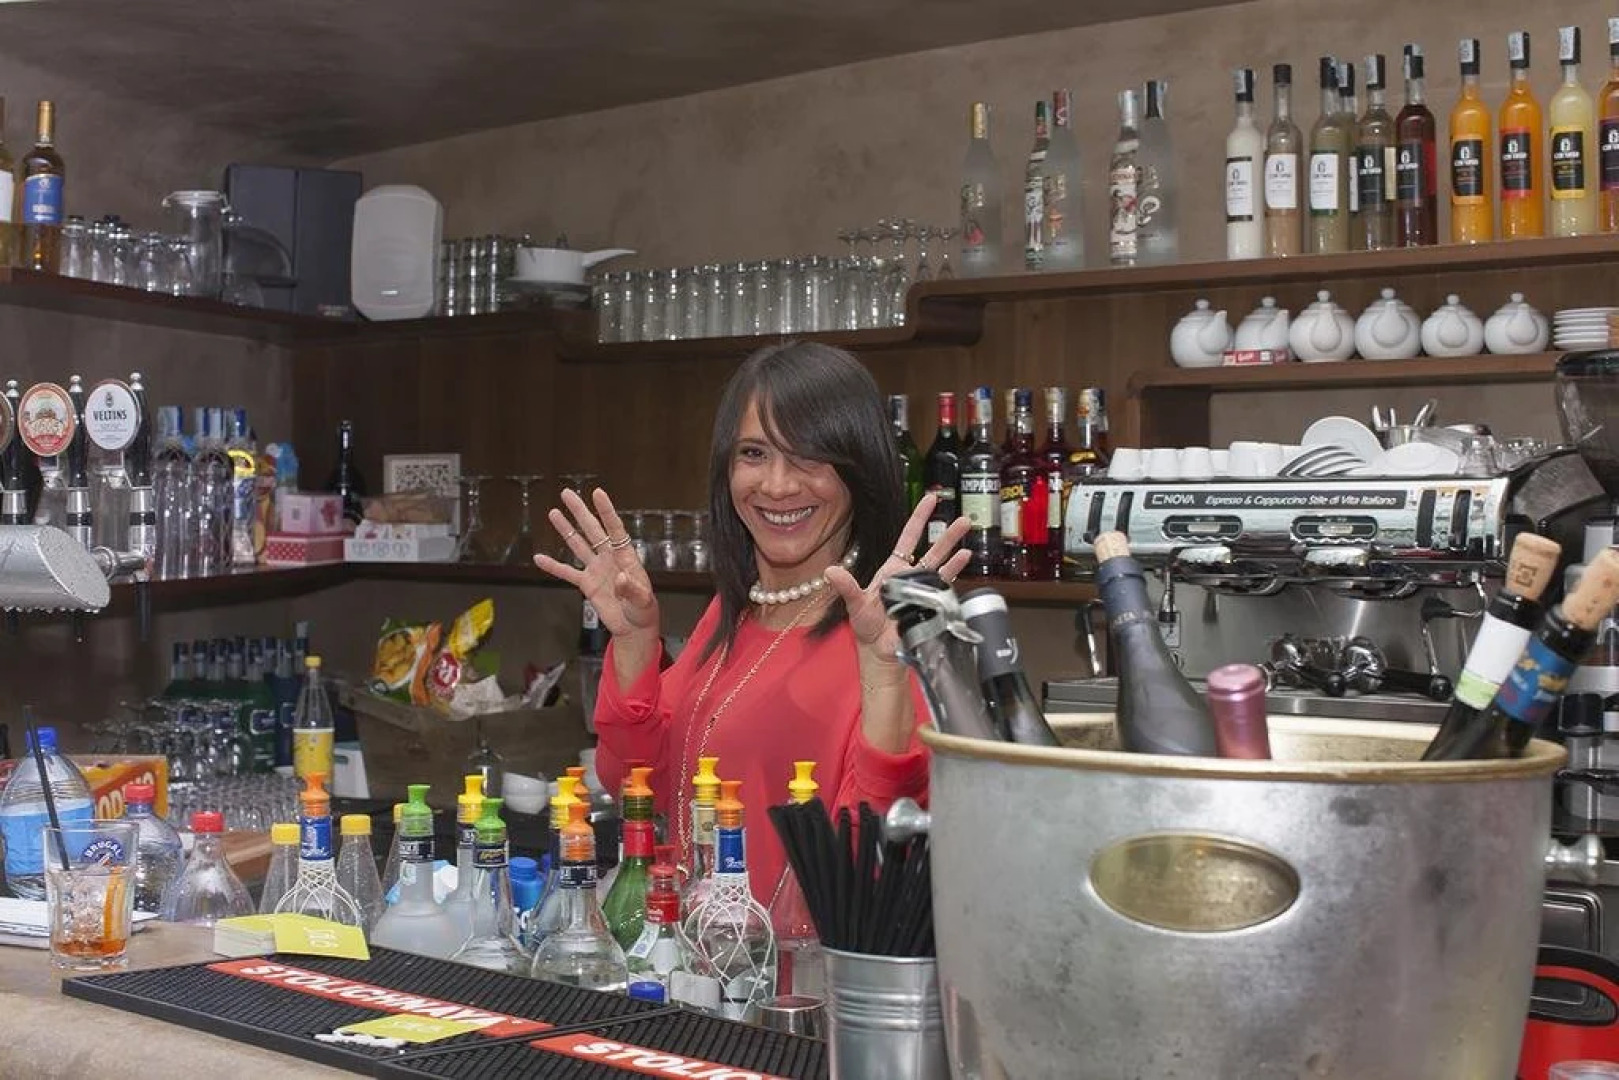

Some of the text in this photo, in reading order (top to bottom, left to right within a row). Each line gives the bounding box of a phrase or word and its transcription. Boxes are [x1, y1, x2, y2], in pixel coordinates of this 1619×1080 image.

[92, 410, 128, 421] VELTINS
[1205, 495, 1243, 506] Espresso
[1244, 495, 1253, 505] &
[1254, 495, 1307, 507] Cappuccino
[1329, 495, 1340, 505] di
[1341, 495, 1359, 505] Vita
[84, 840, 122, 858] BRUGAL
[239, 965, 508, 1026] STOLICHNAYA
